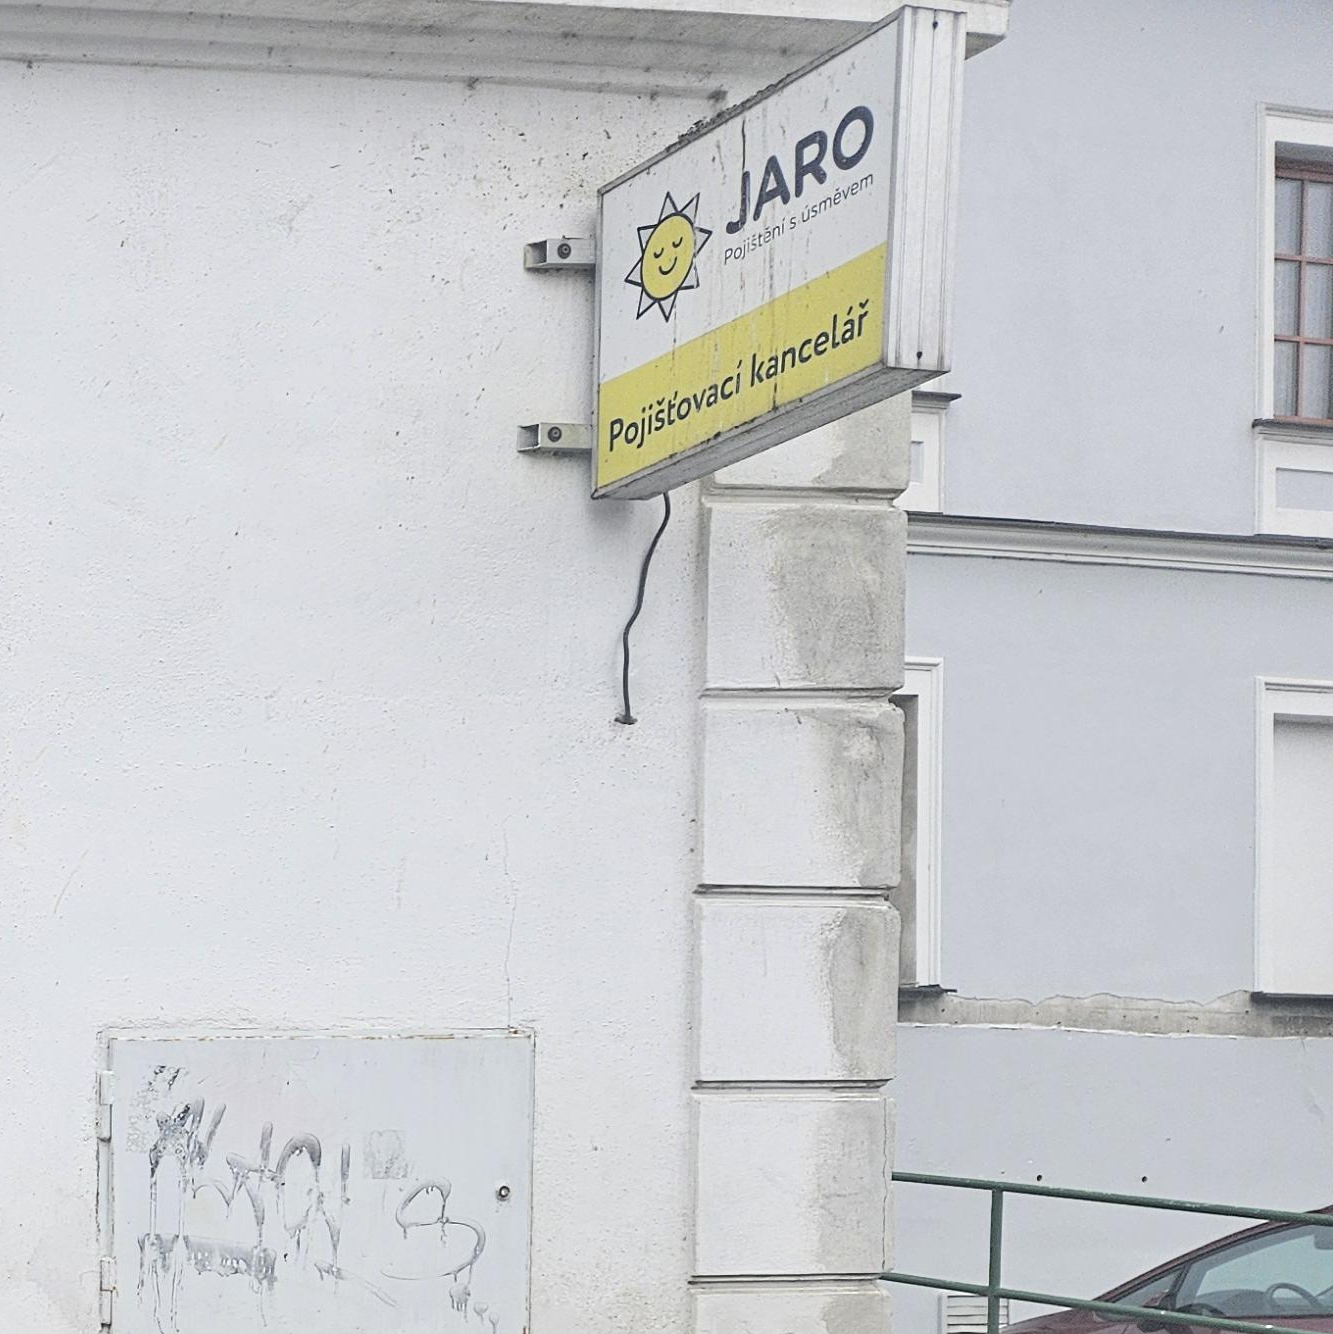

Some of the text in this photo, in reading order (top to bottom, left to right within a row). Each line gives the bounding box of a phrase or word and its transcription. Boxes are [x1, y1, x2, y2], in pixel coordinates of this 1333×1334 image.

[724, 172, 874, 266] Pojištění s úsměvem
[725, 104, 875, 236] JARO
[608, 299, 870, 452] Pojišťovací kancelář
